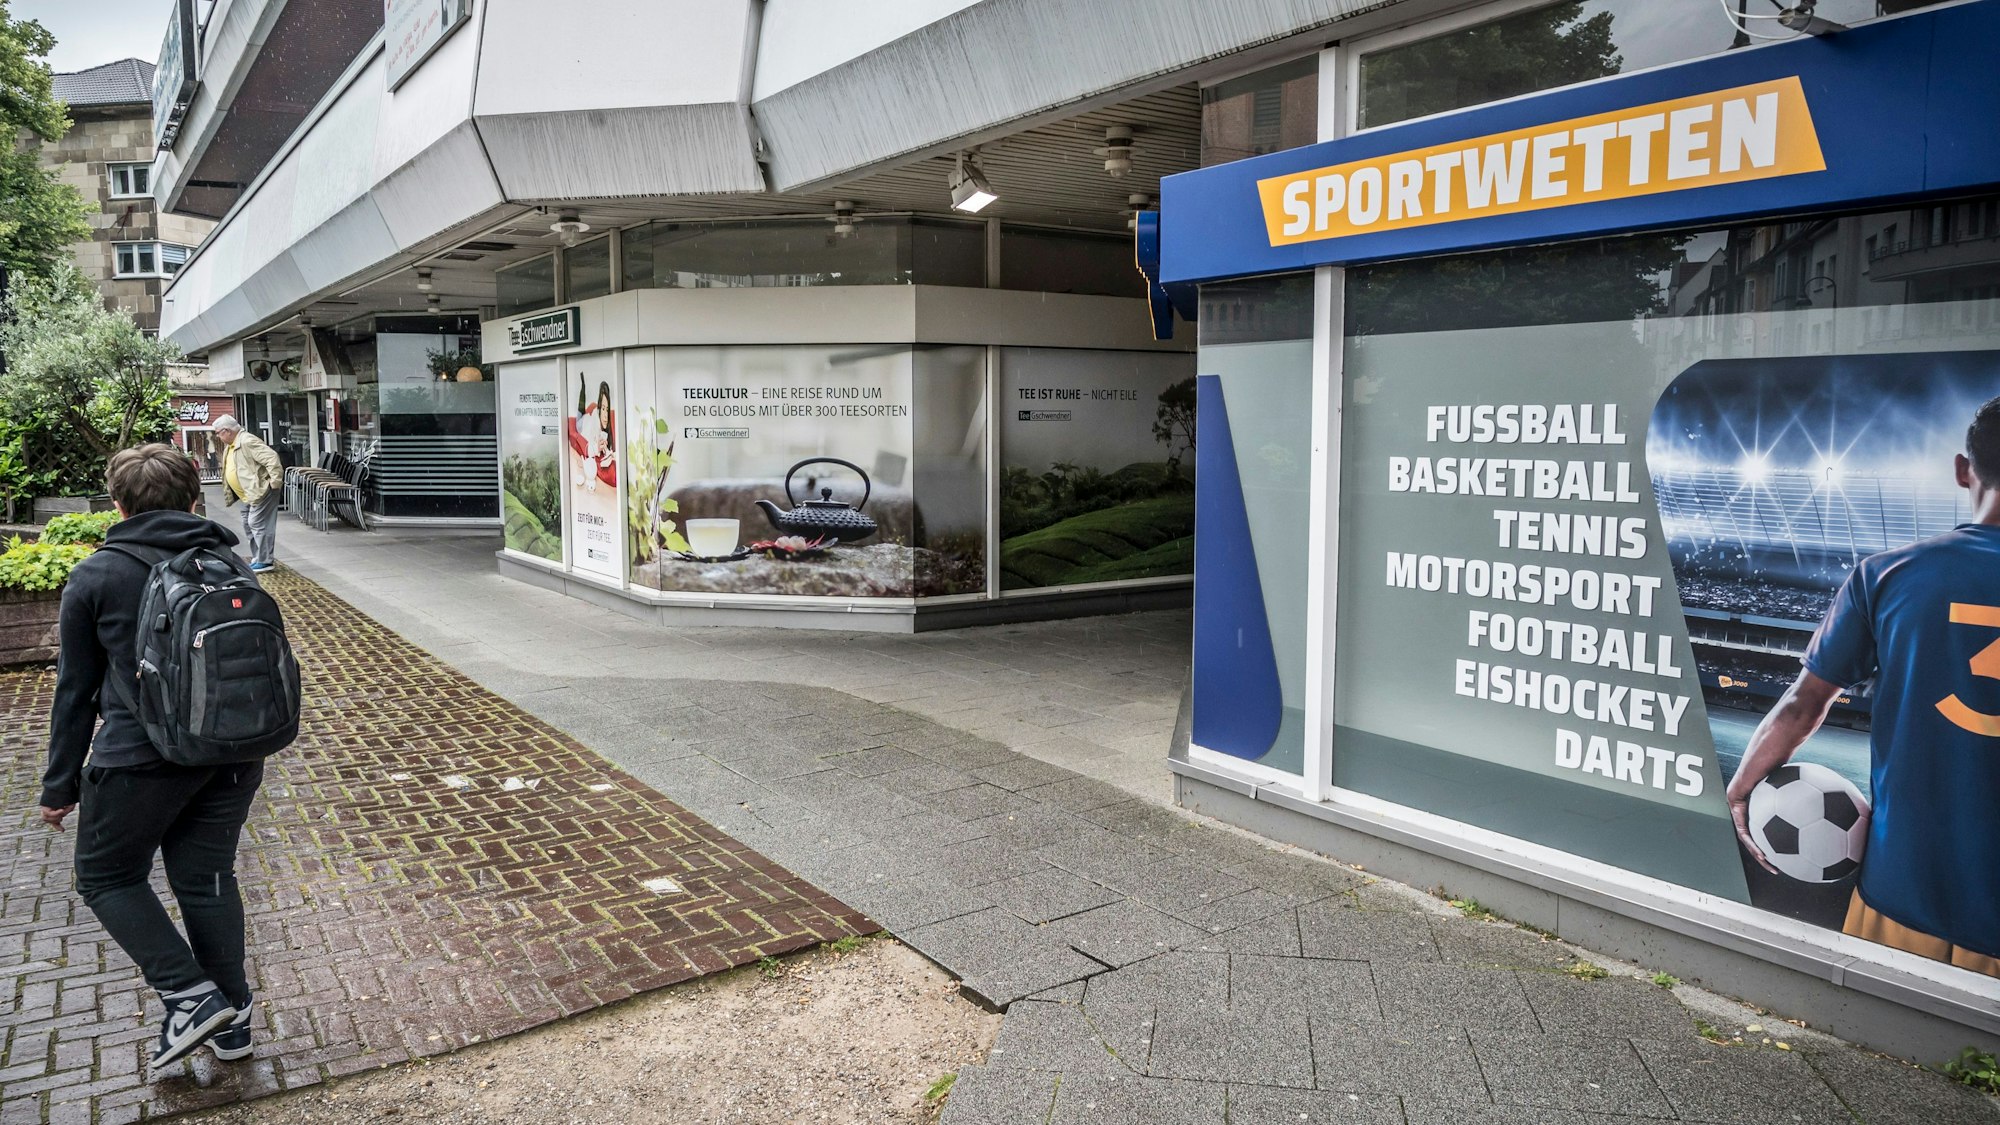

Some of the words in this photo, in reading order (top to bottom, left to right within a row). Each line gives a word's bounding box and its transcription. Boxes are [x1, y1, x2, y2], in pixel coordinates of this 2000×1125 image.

[1283, 92, 1779, 237] SPORTWETTEN
[683, 388, 748, 399] TEEKULTUR
[762, 387, 788, 399] EINE
[791, 387, 823, 399] REISE
[826, 387, 859, 399] RUND
[862, 387, 882, 399] UM
[683, 405, 706, 417] DEN
[709, 405, 756, 417] GLOBUS
[759, 405, 779, 417] MIT
[782, 402, 813, 417] ÜBER
[815, 405, 837, 417] 300
[839, 405, 907, 417] TEESORTEN
[1019, 388, 1036, 400] TEE
[1038, 388, 1054, 400] IST
[1055, 388, 1081, 400] RUHE
[1091, 389, 1118, 401] NICHT
[1120, 390, 1138, 401] EILE
[1426, 403, 1627, 445] FUSSBALL
[1388, 456, 1640, 503] BASKETBALL
[1493, 509, 1647, 559] TENNIS
[1386, 551, 1662, 618] MOTORSPORT
[1468, 609, 1682, 679] FOOTBALL
[1455, 658, 1691, 736] EISHOCKEY
[1555, 728, 1704, 797] DARTS
